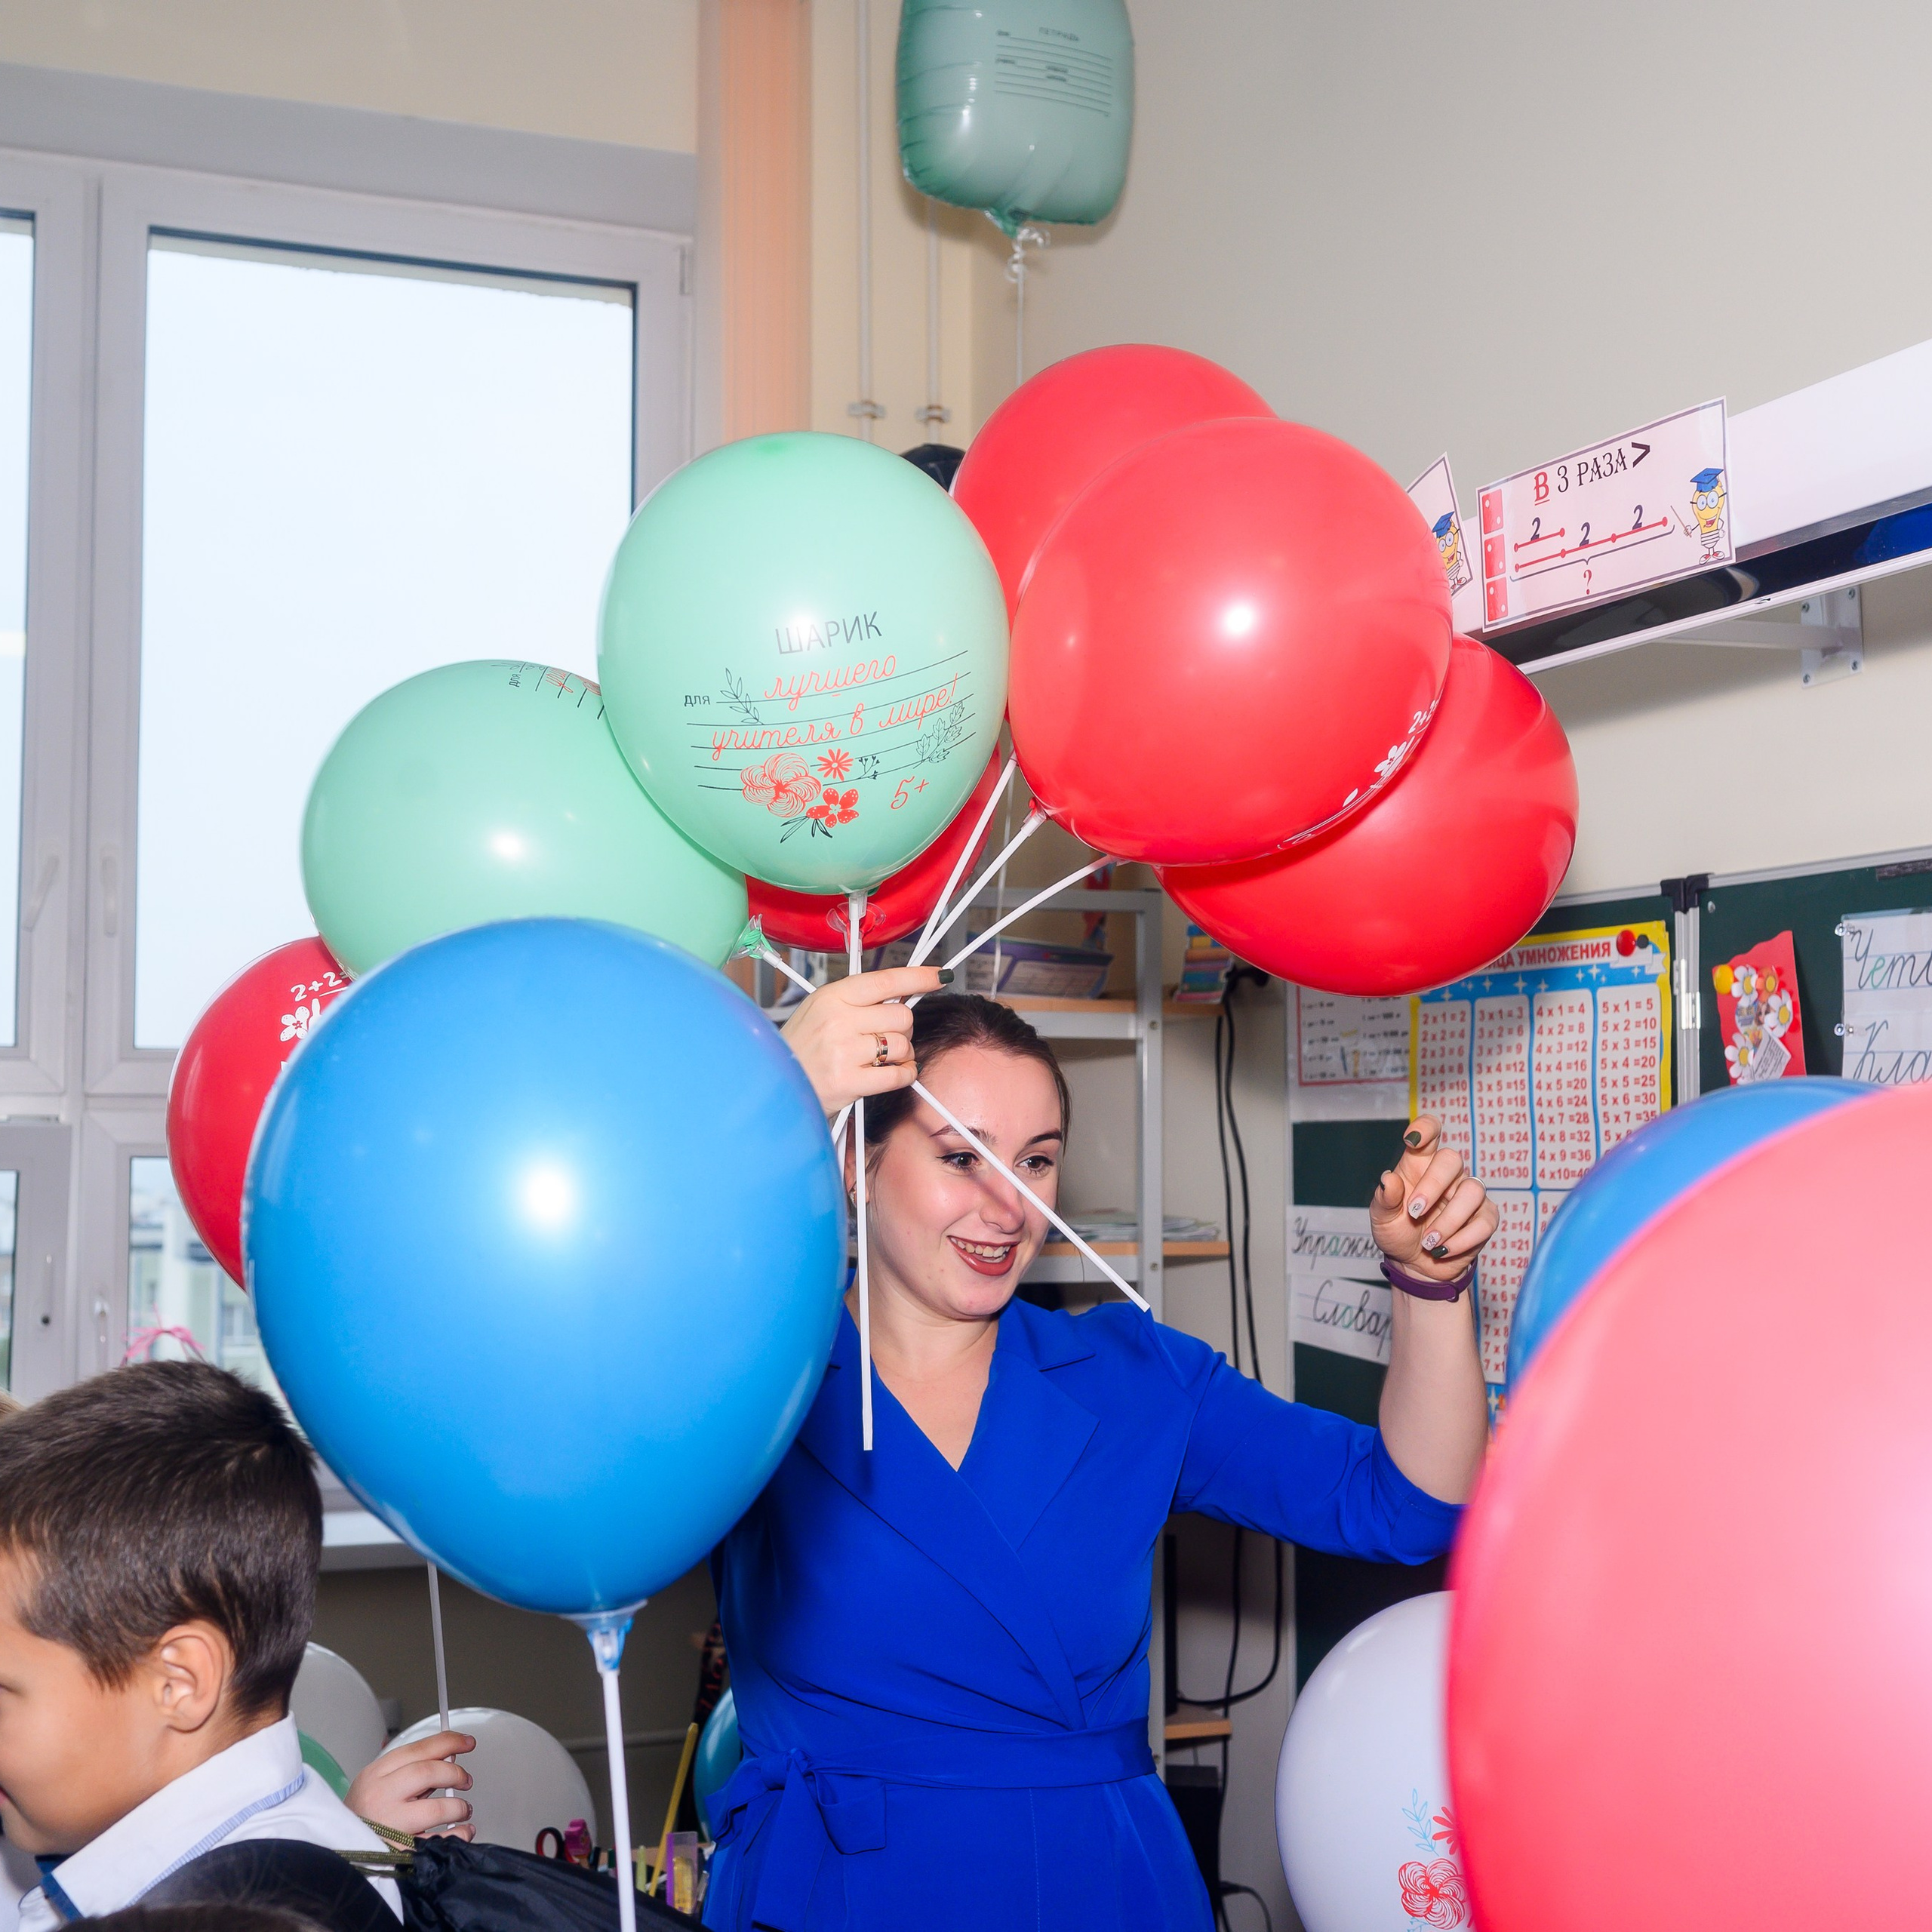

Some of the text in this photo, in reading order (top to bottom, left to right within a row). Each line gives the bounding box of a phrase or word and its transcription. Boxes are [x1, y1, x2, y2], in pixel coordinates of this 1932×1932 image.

[1557, 465, 1570, 493] 3
[1531, 516, 1541, 541] 2
[1632, 504, 1644, 530] 2
[1579, 521, 1591, 547] 2
[1583, 568, 1592, 595] ?
[774, 611, 882, 655] ШАРИК
[764, 654, 897, 711] лучшего
[712, 672, 959, 761] учителя в мире!
[890, 775, 931, 811] 5+
[1517, 940, 1612, 967] УМНОЖЕНИЯ
